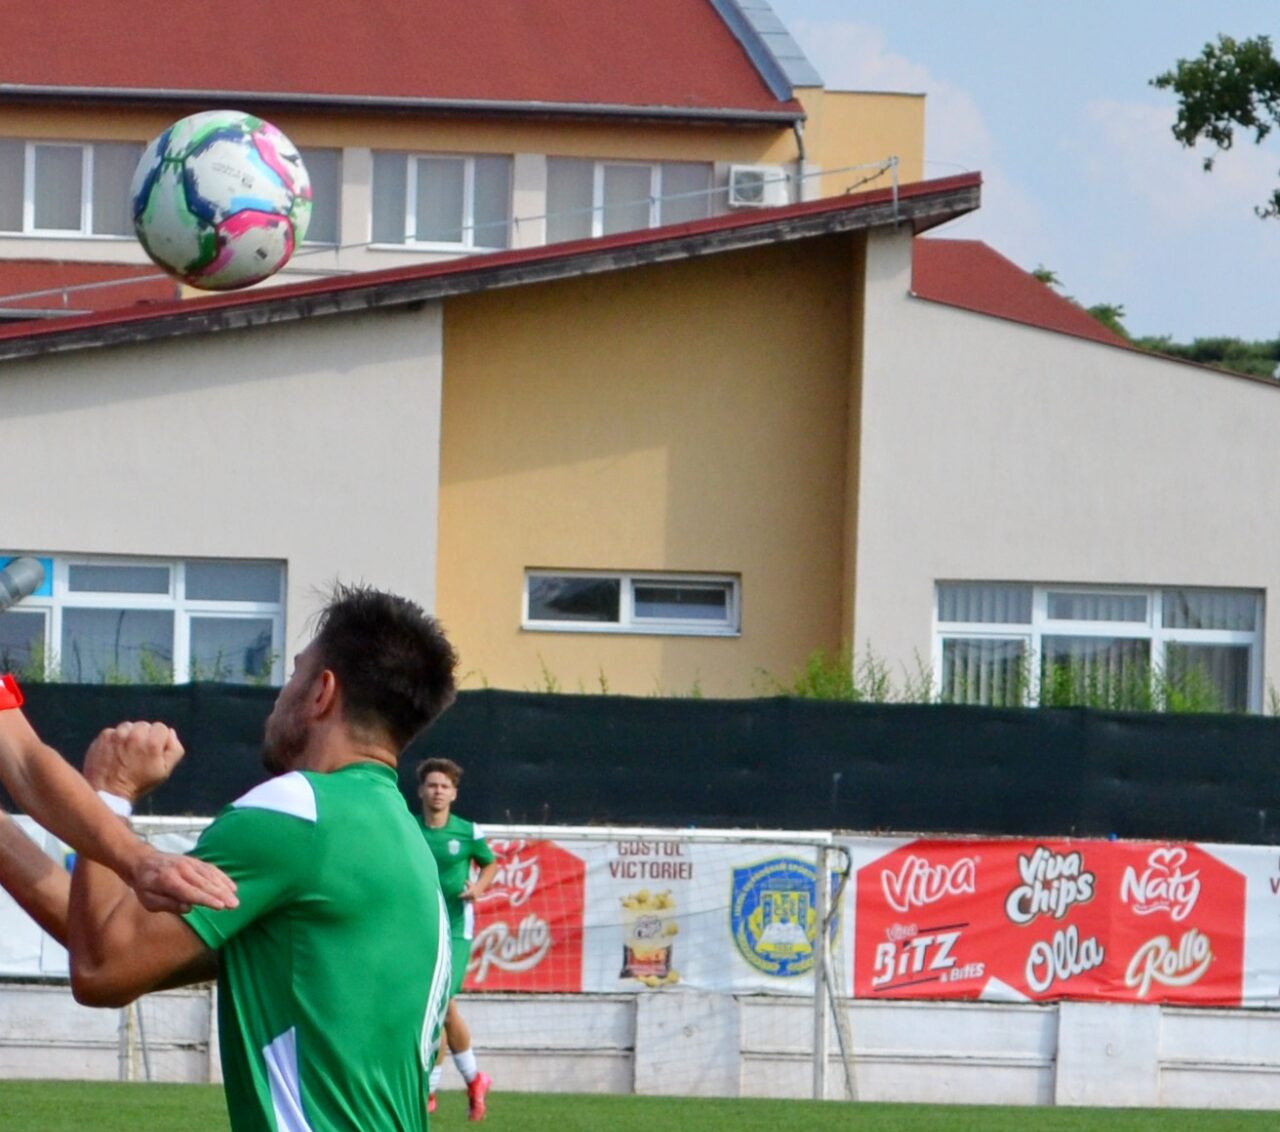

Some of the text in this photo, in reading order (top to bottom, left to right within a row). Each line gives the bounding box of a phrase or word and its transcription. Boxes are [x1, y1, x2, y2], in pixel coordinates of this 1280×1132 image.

[609, 861, 694, 880] VICTORIEI
[617, 840, 684, 857] GUSTUL
[1019, 847, 1081, 885] Viva
[881, 855, 976, 912] Viva
[1005, 872, 1094, 924] Chips
[1121, 865, 1201, 922] Naty
[467, 914, 552, 983] Rollo
[1025, 924, 1104, 993] Olla
[1124, 928, 1213, 999] Rollo
